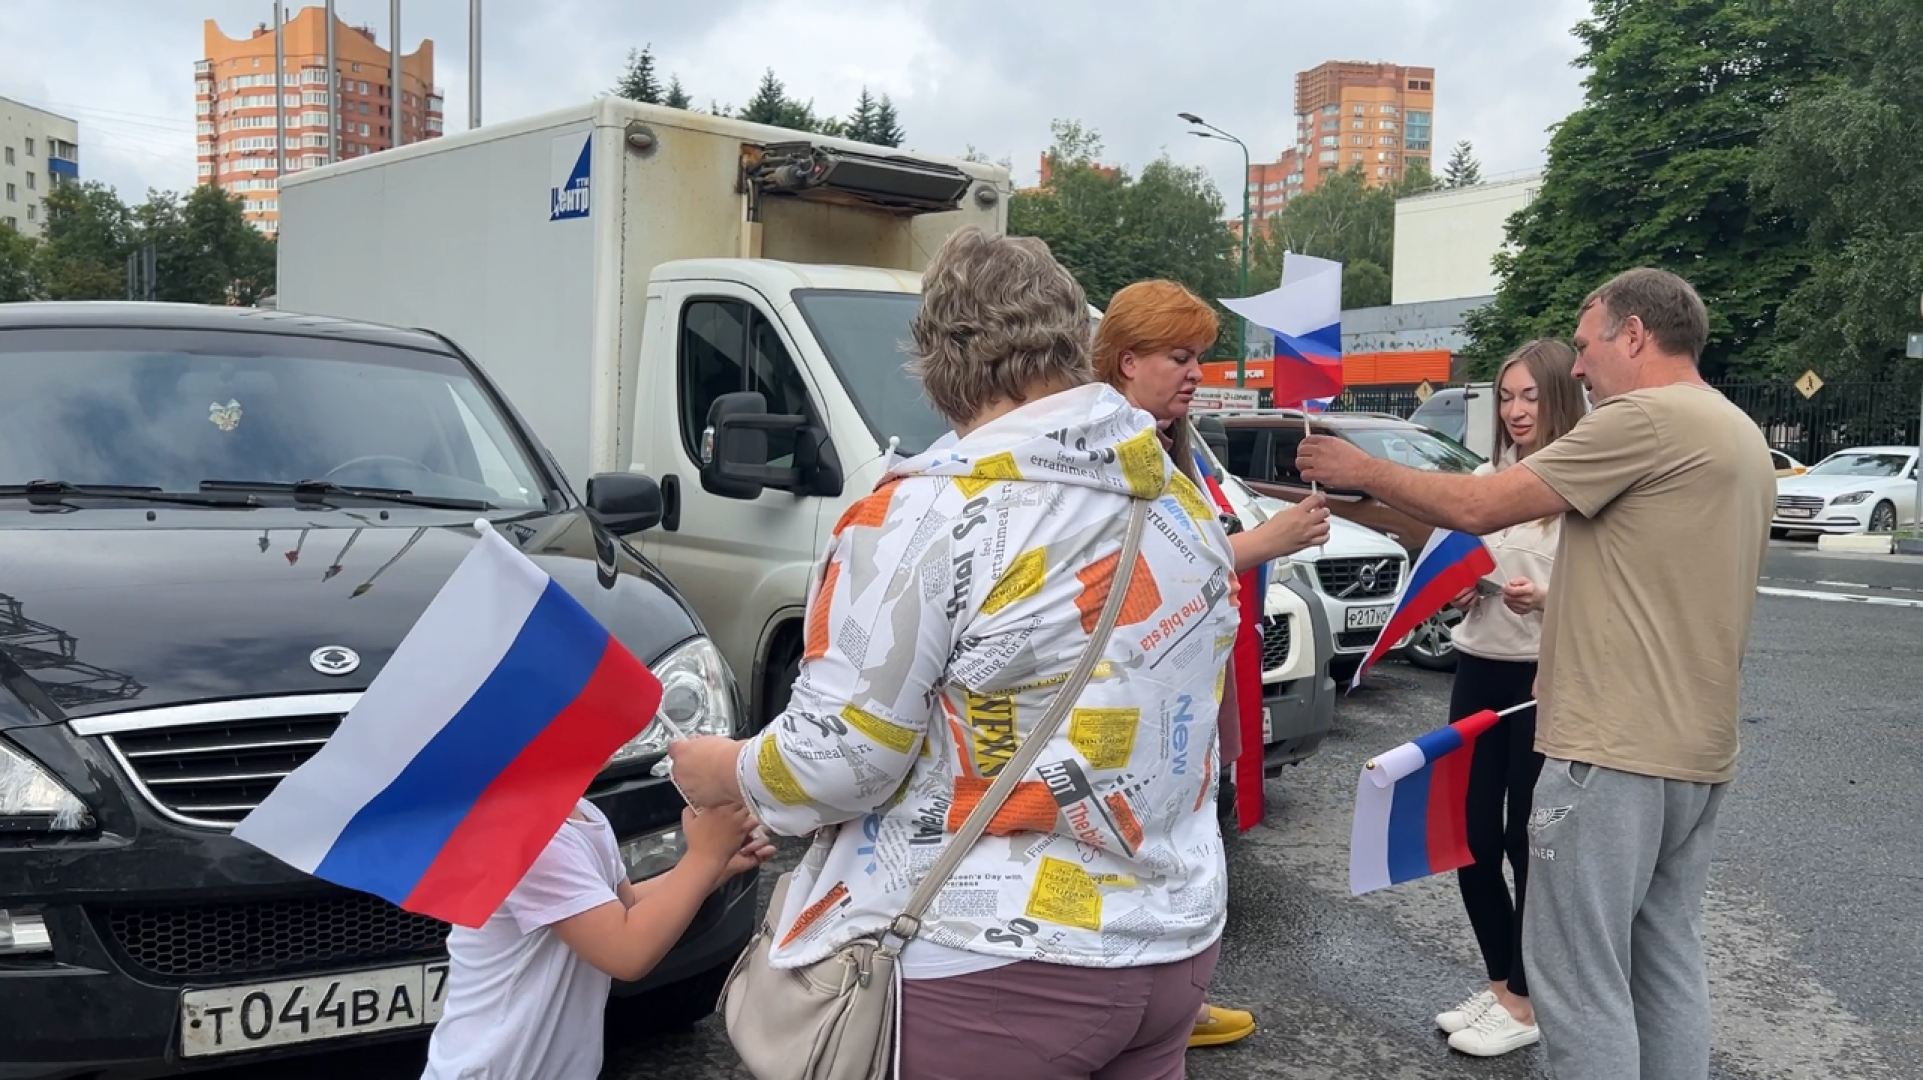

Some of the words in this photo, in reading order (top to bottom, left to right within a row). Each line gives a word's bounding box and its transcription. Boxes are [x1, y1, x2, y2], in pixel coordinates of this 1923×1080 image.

[1159, 612, 1185, 638] big
[1172, 694, 1194, 775] New
[1040, 761, 1077, 797] HOT
[1066, 801, 1091, 831] The
